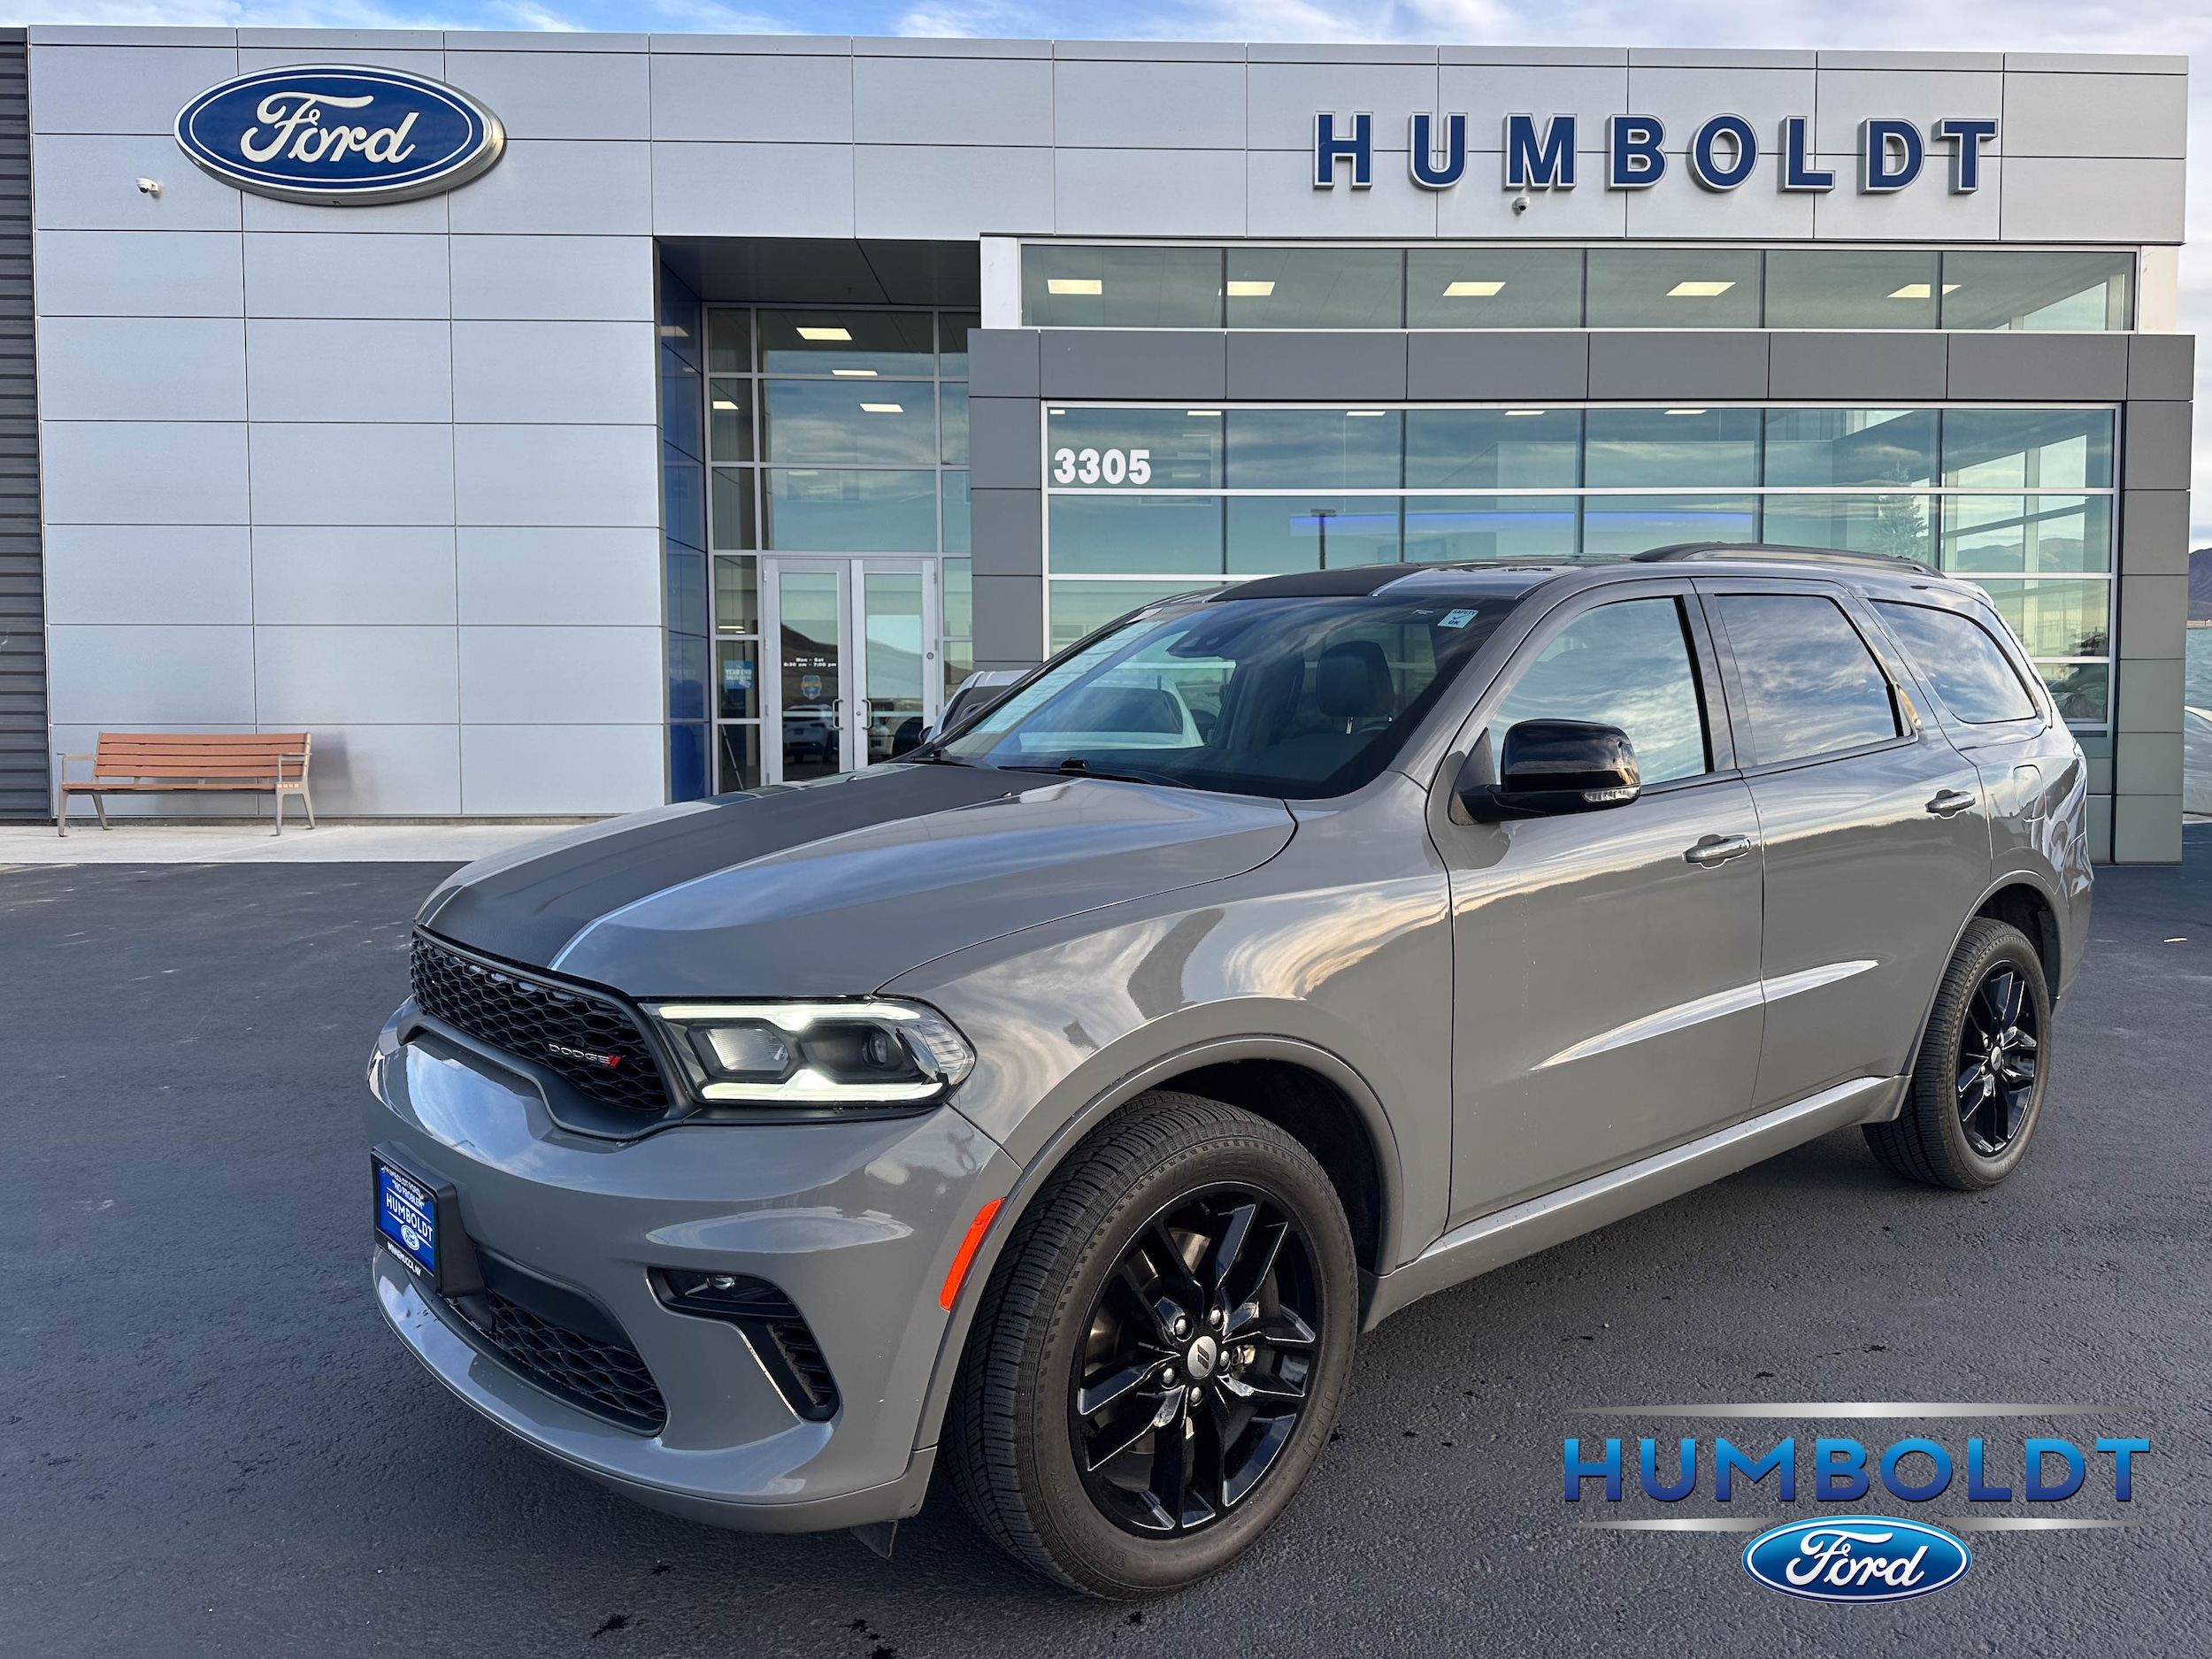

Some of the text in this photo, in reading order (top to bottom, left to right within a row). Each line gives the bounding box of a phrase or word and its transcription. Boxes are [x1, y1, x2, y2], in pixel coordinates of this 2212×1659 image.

[241, 91, 420, 164] Ford
[1313, 111, 1999, 195] HUMBOLDT
[1054, 448, 1151, 485] 3305
[549, 1043, 611, 1064] DODGE
[386, 1193, 433, 1241] HUMBOLDT
